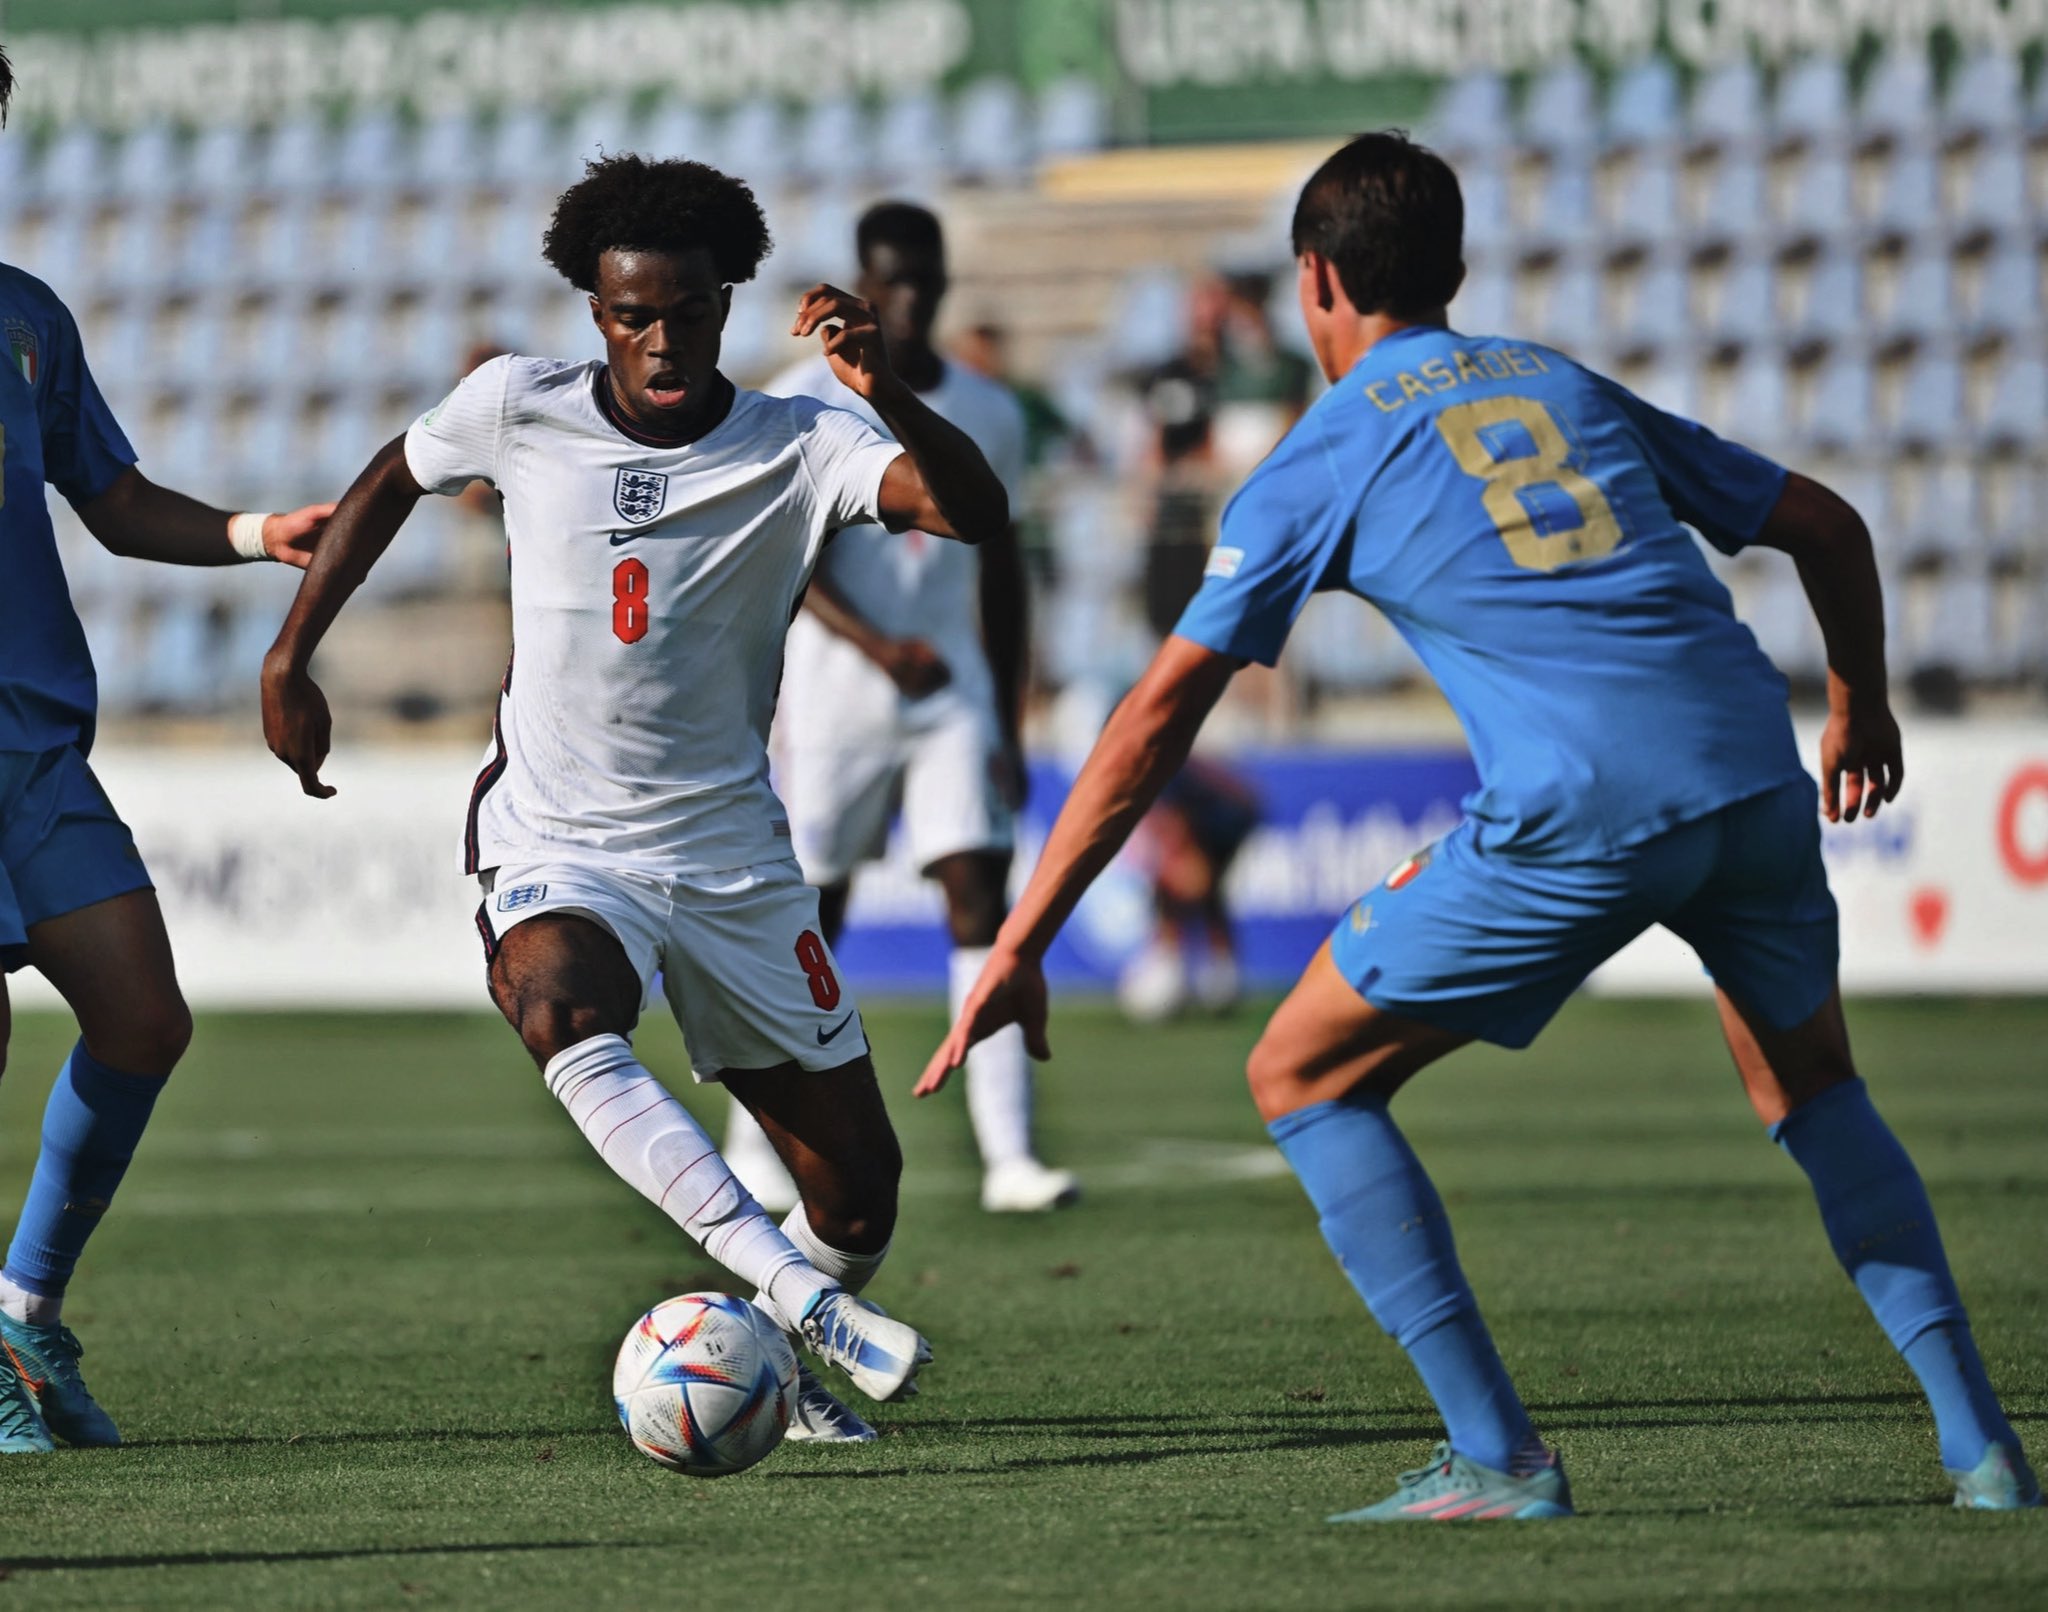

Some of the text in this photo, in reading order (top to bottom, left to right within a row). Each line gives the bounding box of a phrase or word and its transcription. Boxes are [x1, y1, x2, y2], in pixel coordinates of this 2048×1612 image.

[1364, 350, 1550, 412] CASADEI
[1436, 395, 1623, 574] 8
[612, 557, 649, 644] 8
[794, 929, 841, 1012] 8
